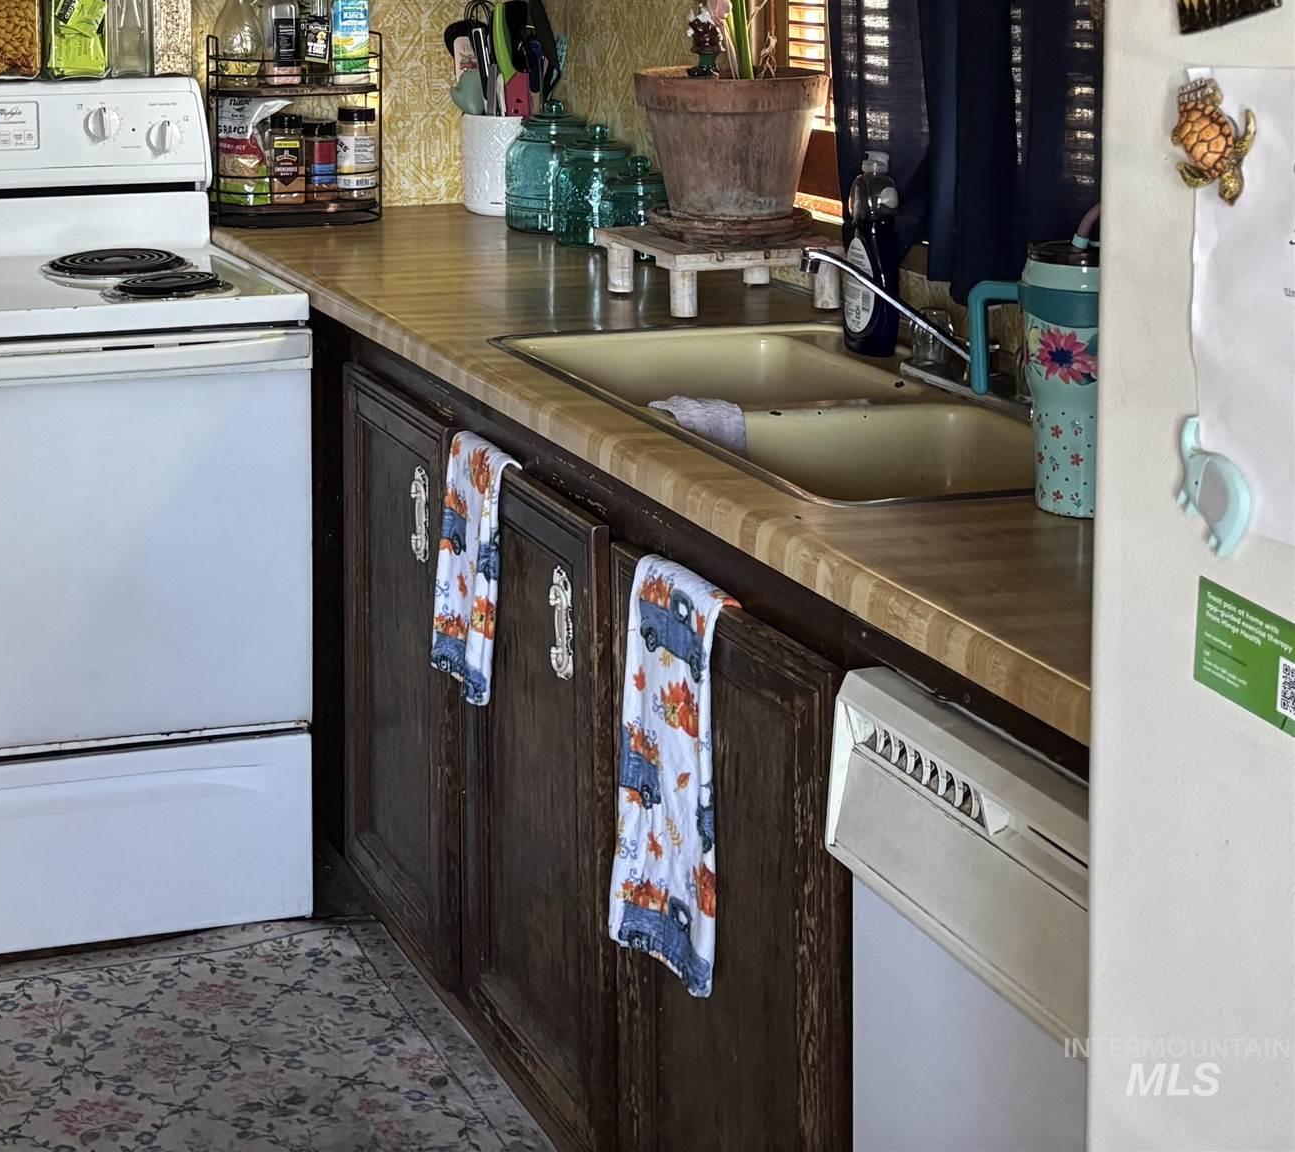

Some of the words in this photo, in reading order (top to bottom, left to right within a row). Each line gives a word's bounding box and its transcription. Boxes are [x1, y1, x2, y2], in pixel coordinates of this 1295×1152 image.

[1245, 611, 1263, 626] home
[1265, 622, 1279, 636] with
[1267, 633, 1293, 654] therapy
